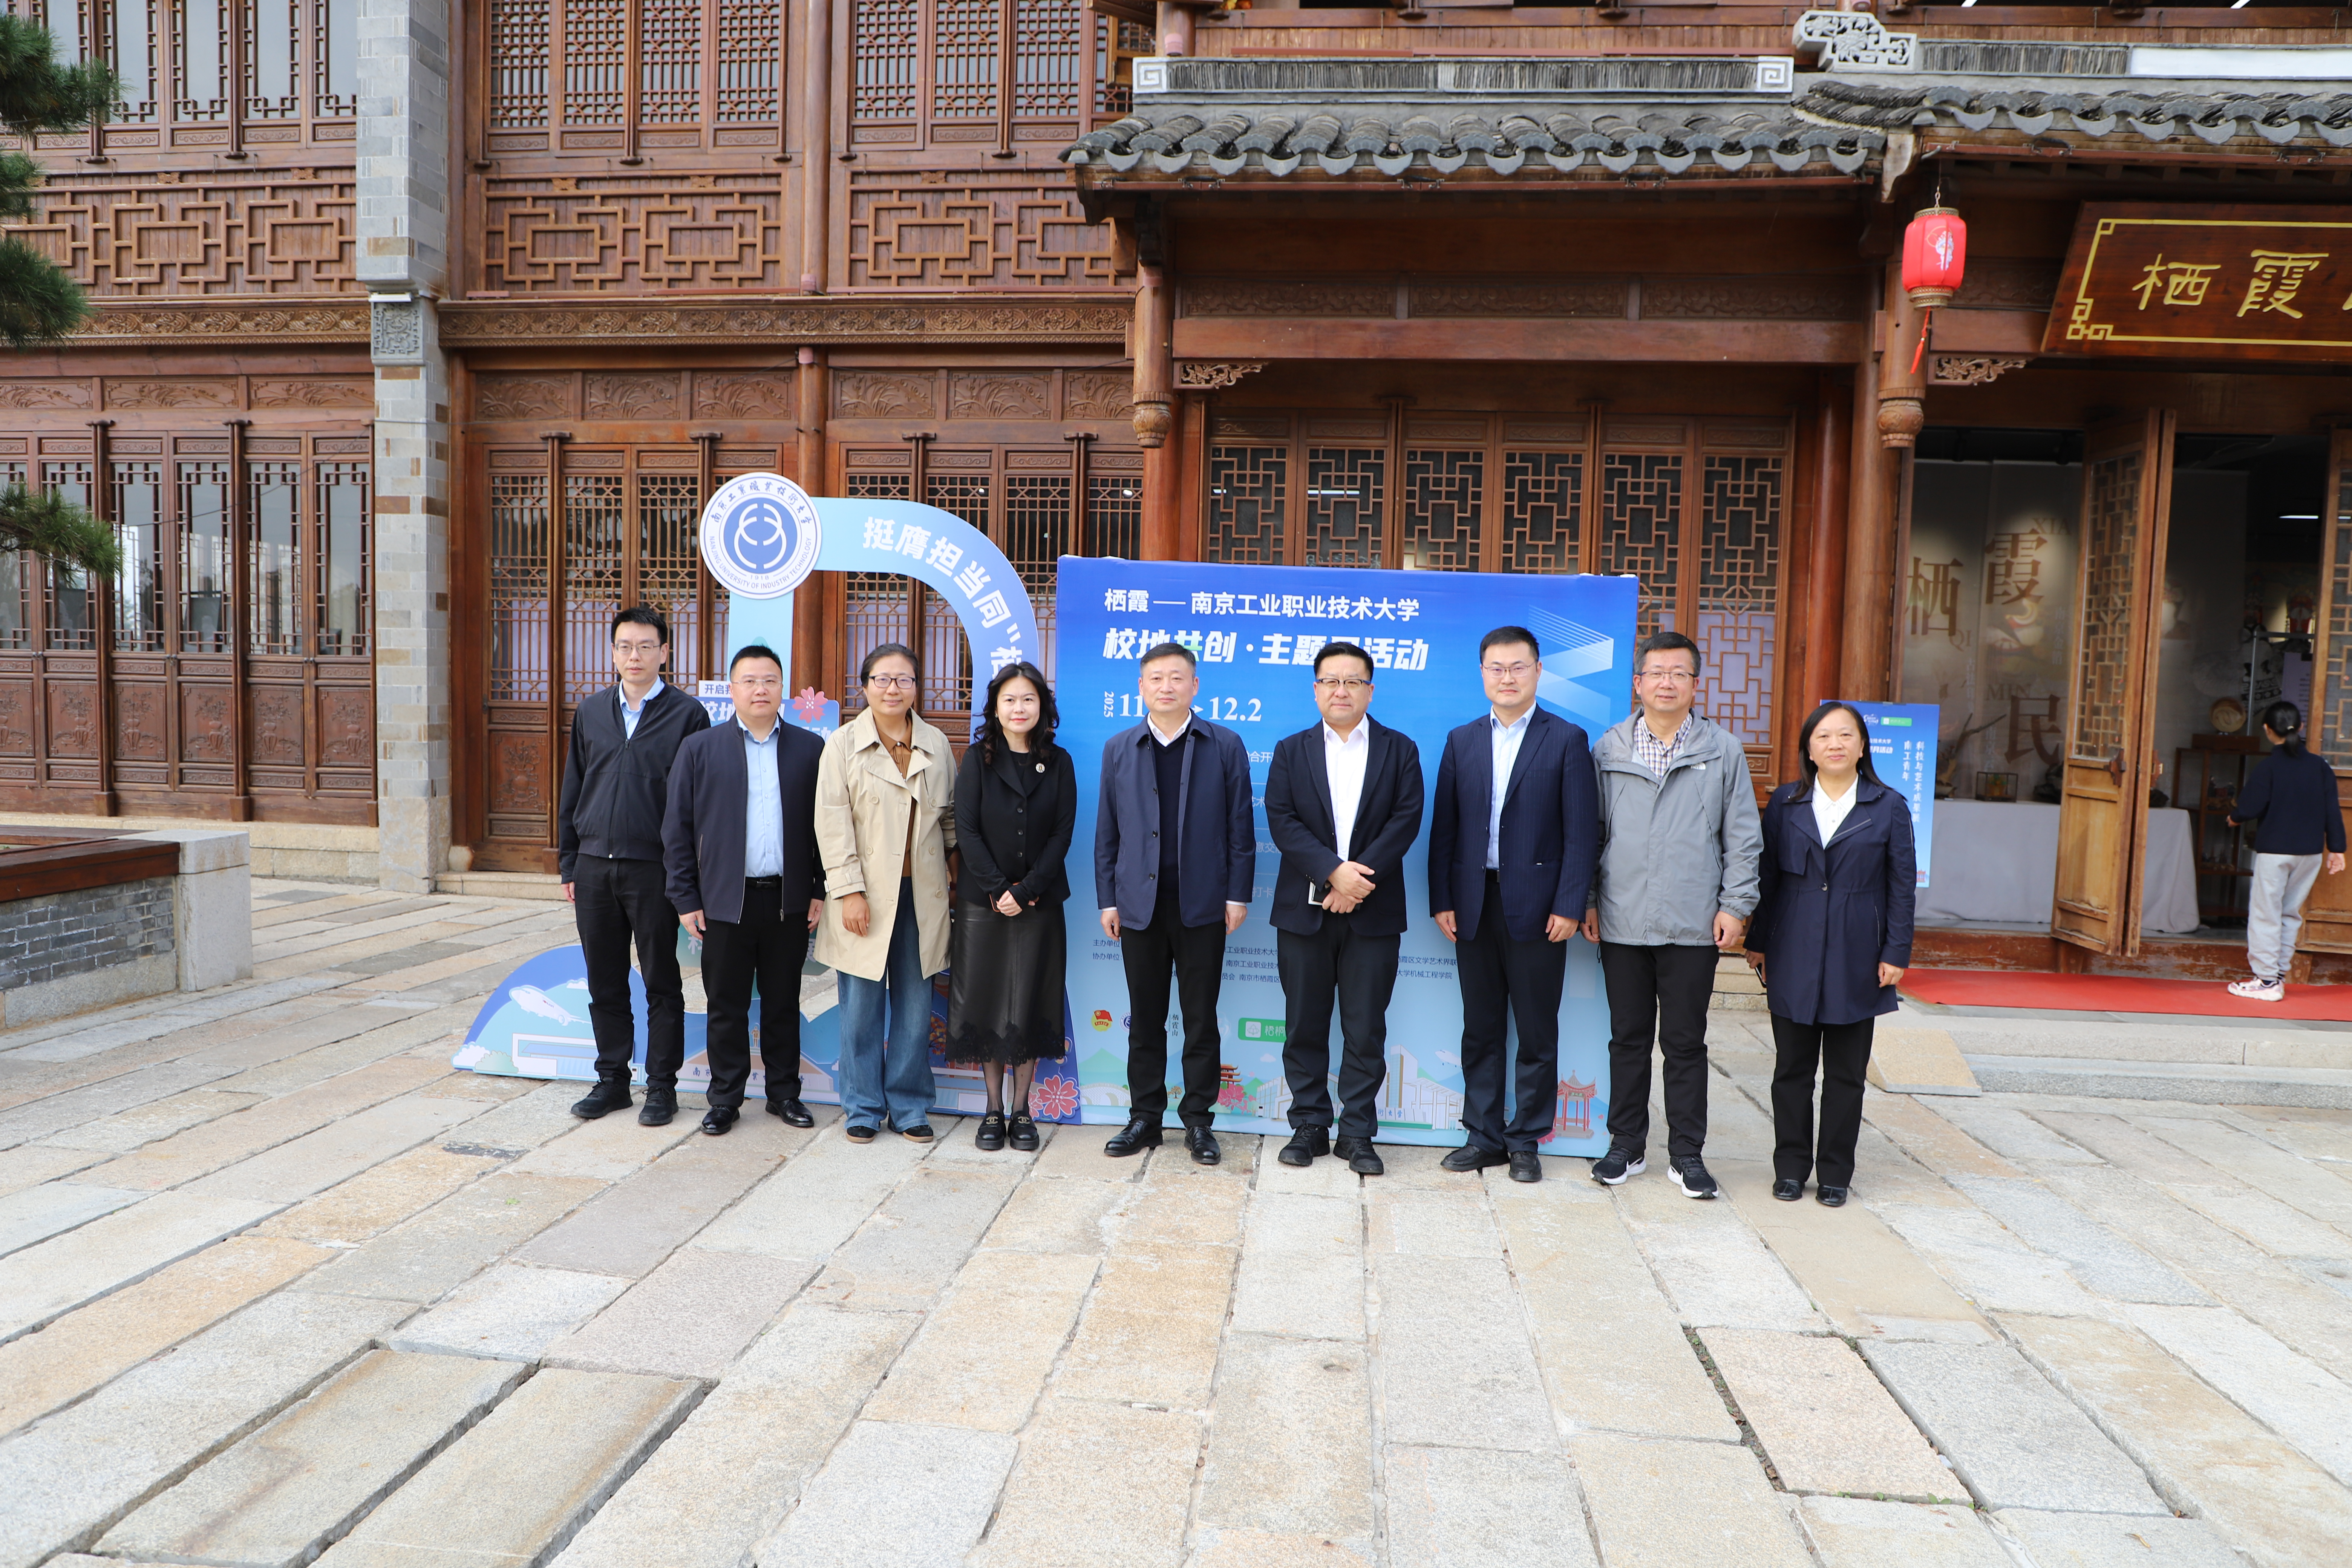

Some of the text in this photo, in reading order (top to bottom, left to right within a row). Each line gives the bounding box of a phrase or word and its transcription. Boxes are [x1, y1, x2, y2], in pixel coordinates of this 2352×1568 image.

[2132, 249, 2352, 319] 栖霞
[2033, 518, 2072, 535] XIA
[709, 536, 720, 564] NANJING
[719, 563, 750, 587] UNIVERSITY
[761, 574, 790, 589] INDUSTRY
[789, 537, 812, 578] TECHNOLOGY
[1985, 528, 2047, 605] 霞
[1904, 556, 1963, 637] 栖
[1102, 628, 1429, 671] 校地共创·主题活动
[1949, 629, 1971, 651] QI
[1104, 691, 1115, 718] 2025
[1209, 697, 1262, 722] 12.2
[1987, 683, 2032, 701] MIN
[2004, 694, 2063, 765] 民
[1902, 740, 1912, 781] 南工青年
[1912, 741, 1925, 822] 科技与艺术成果展
